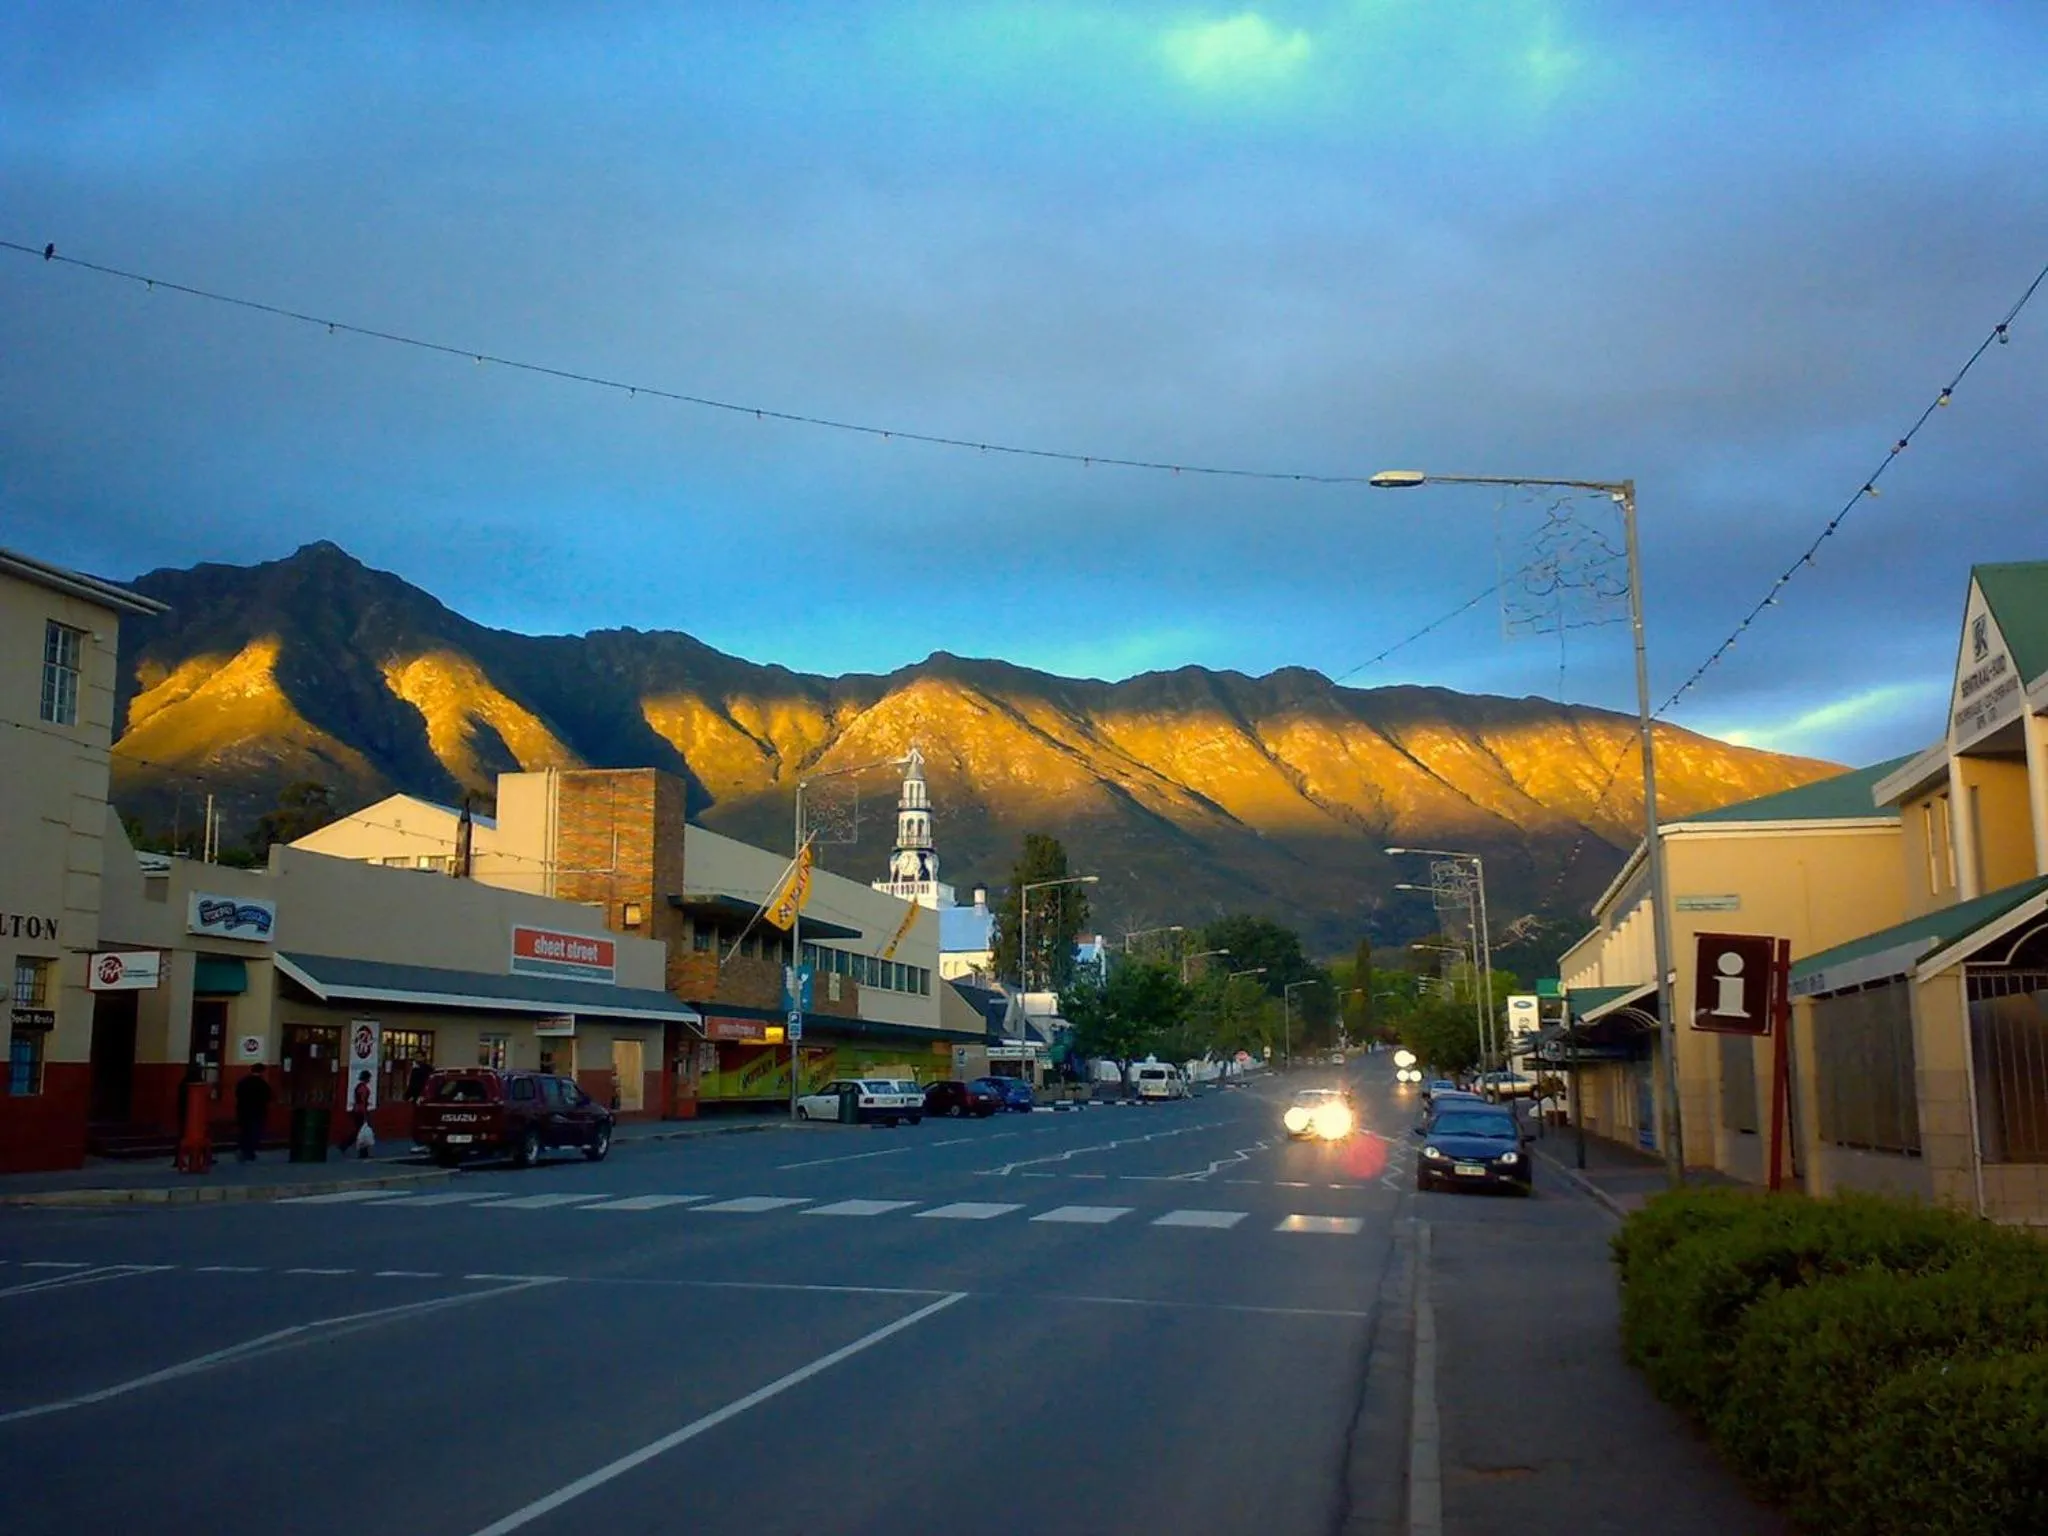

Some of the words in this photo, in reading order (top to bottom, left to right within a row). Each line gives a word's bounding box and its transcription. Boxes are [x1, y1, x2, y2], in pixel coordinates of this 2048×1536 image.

[533, 935, 565, 957] sheet
[567, 941, 598, 962] street
[441, 1113, 477, 1122] ISUZU
